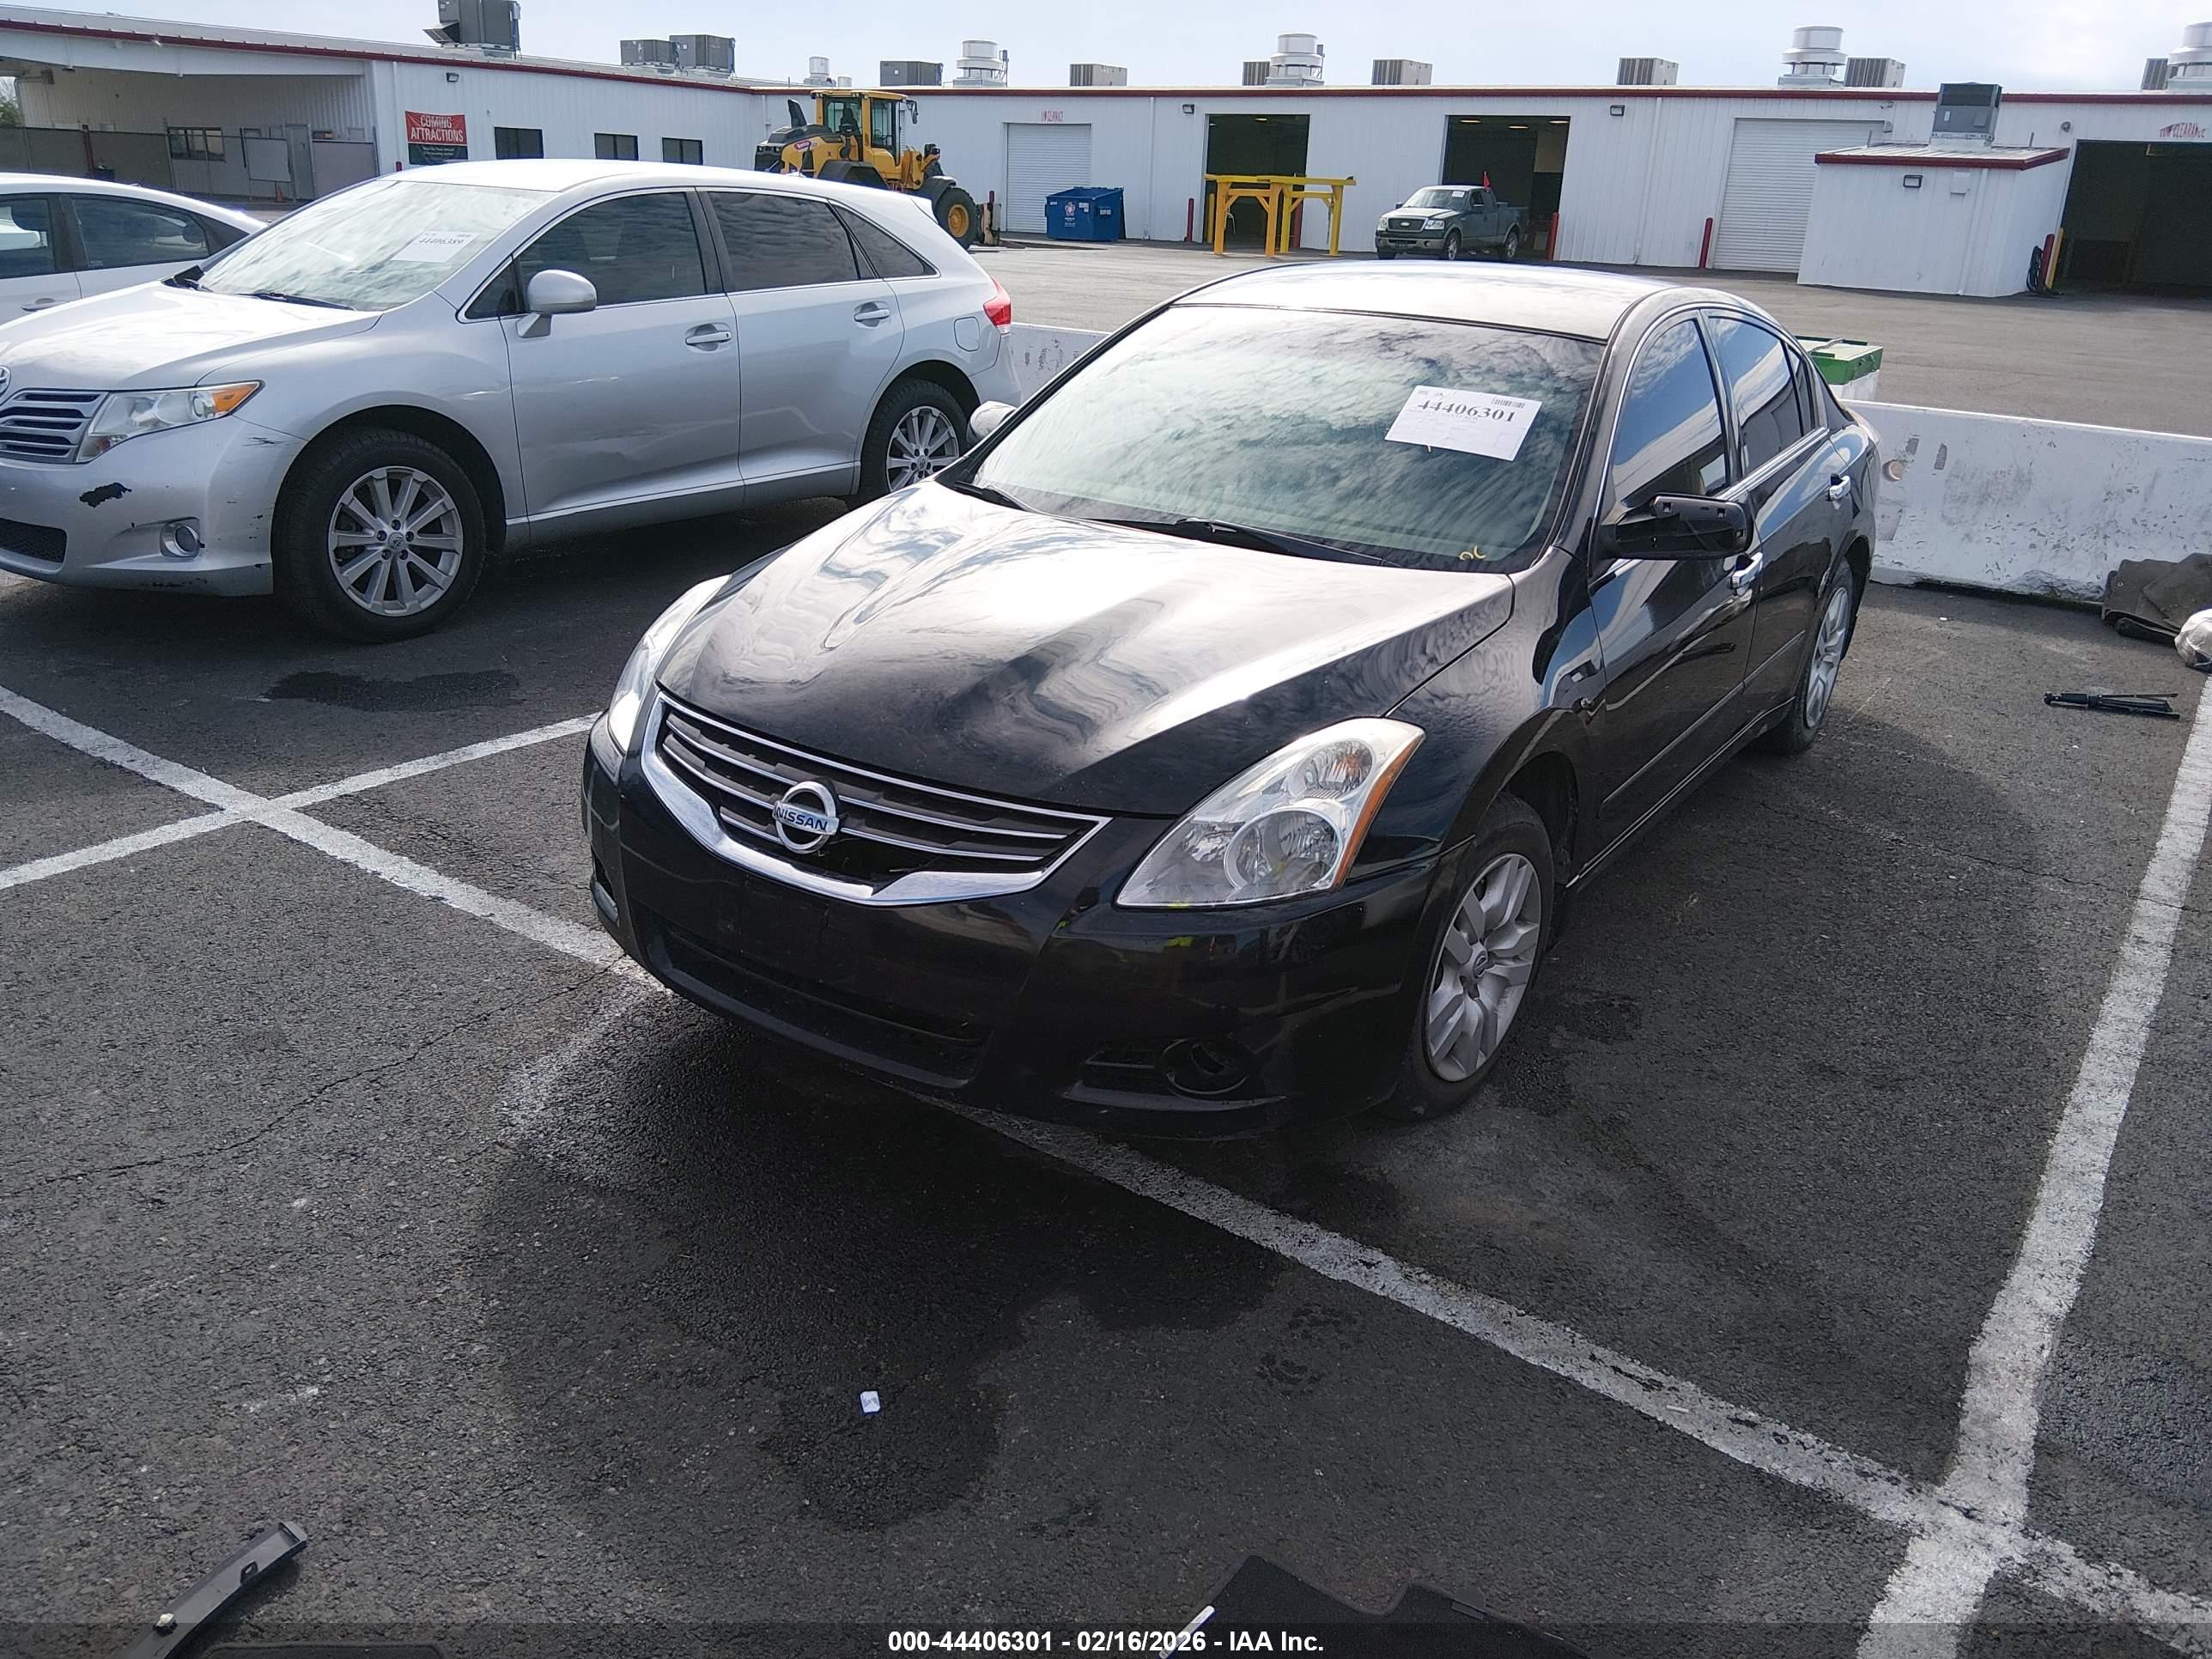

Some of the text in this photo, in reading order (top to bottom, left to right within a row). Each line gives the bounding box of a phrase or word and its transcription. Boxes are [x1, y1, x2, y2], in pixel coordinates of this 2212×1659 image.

[420, 115, 453, 129] COMING
[411, 127, 464, 143] ATTRACTIONS
[2172, 123, 2205, 138] CLEARANCE
[1418, 399, 1516, 422] 44406301
[774, 806, 829, 831] NISSAN
